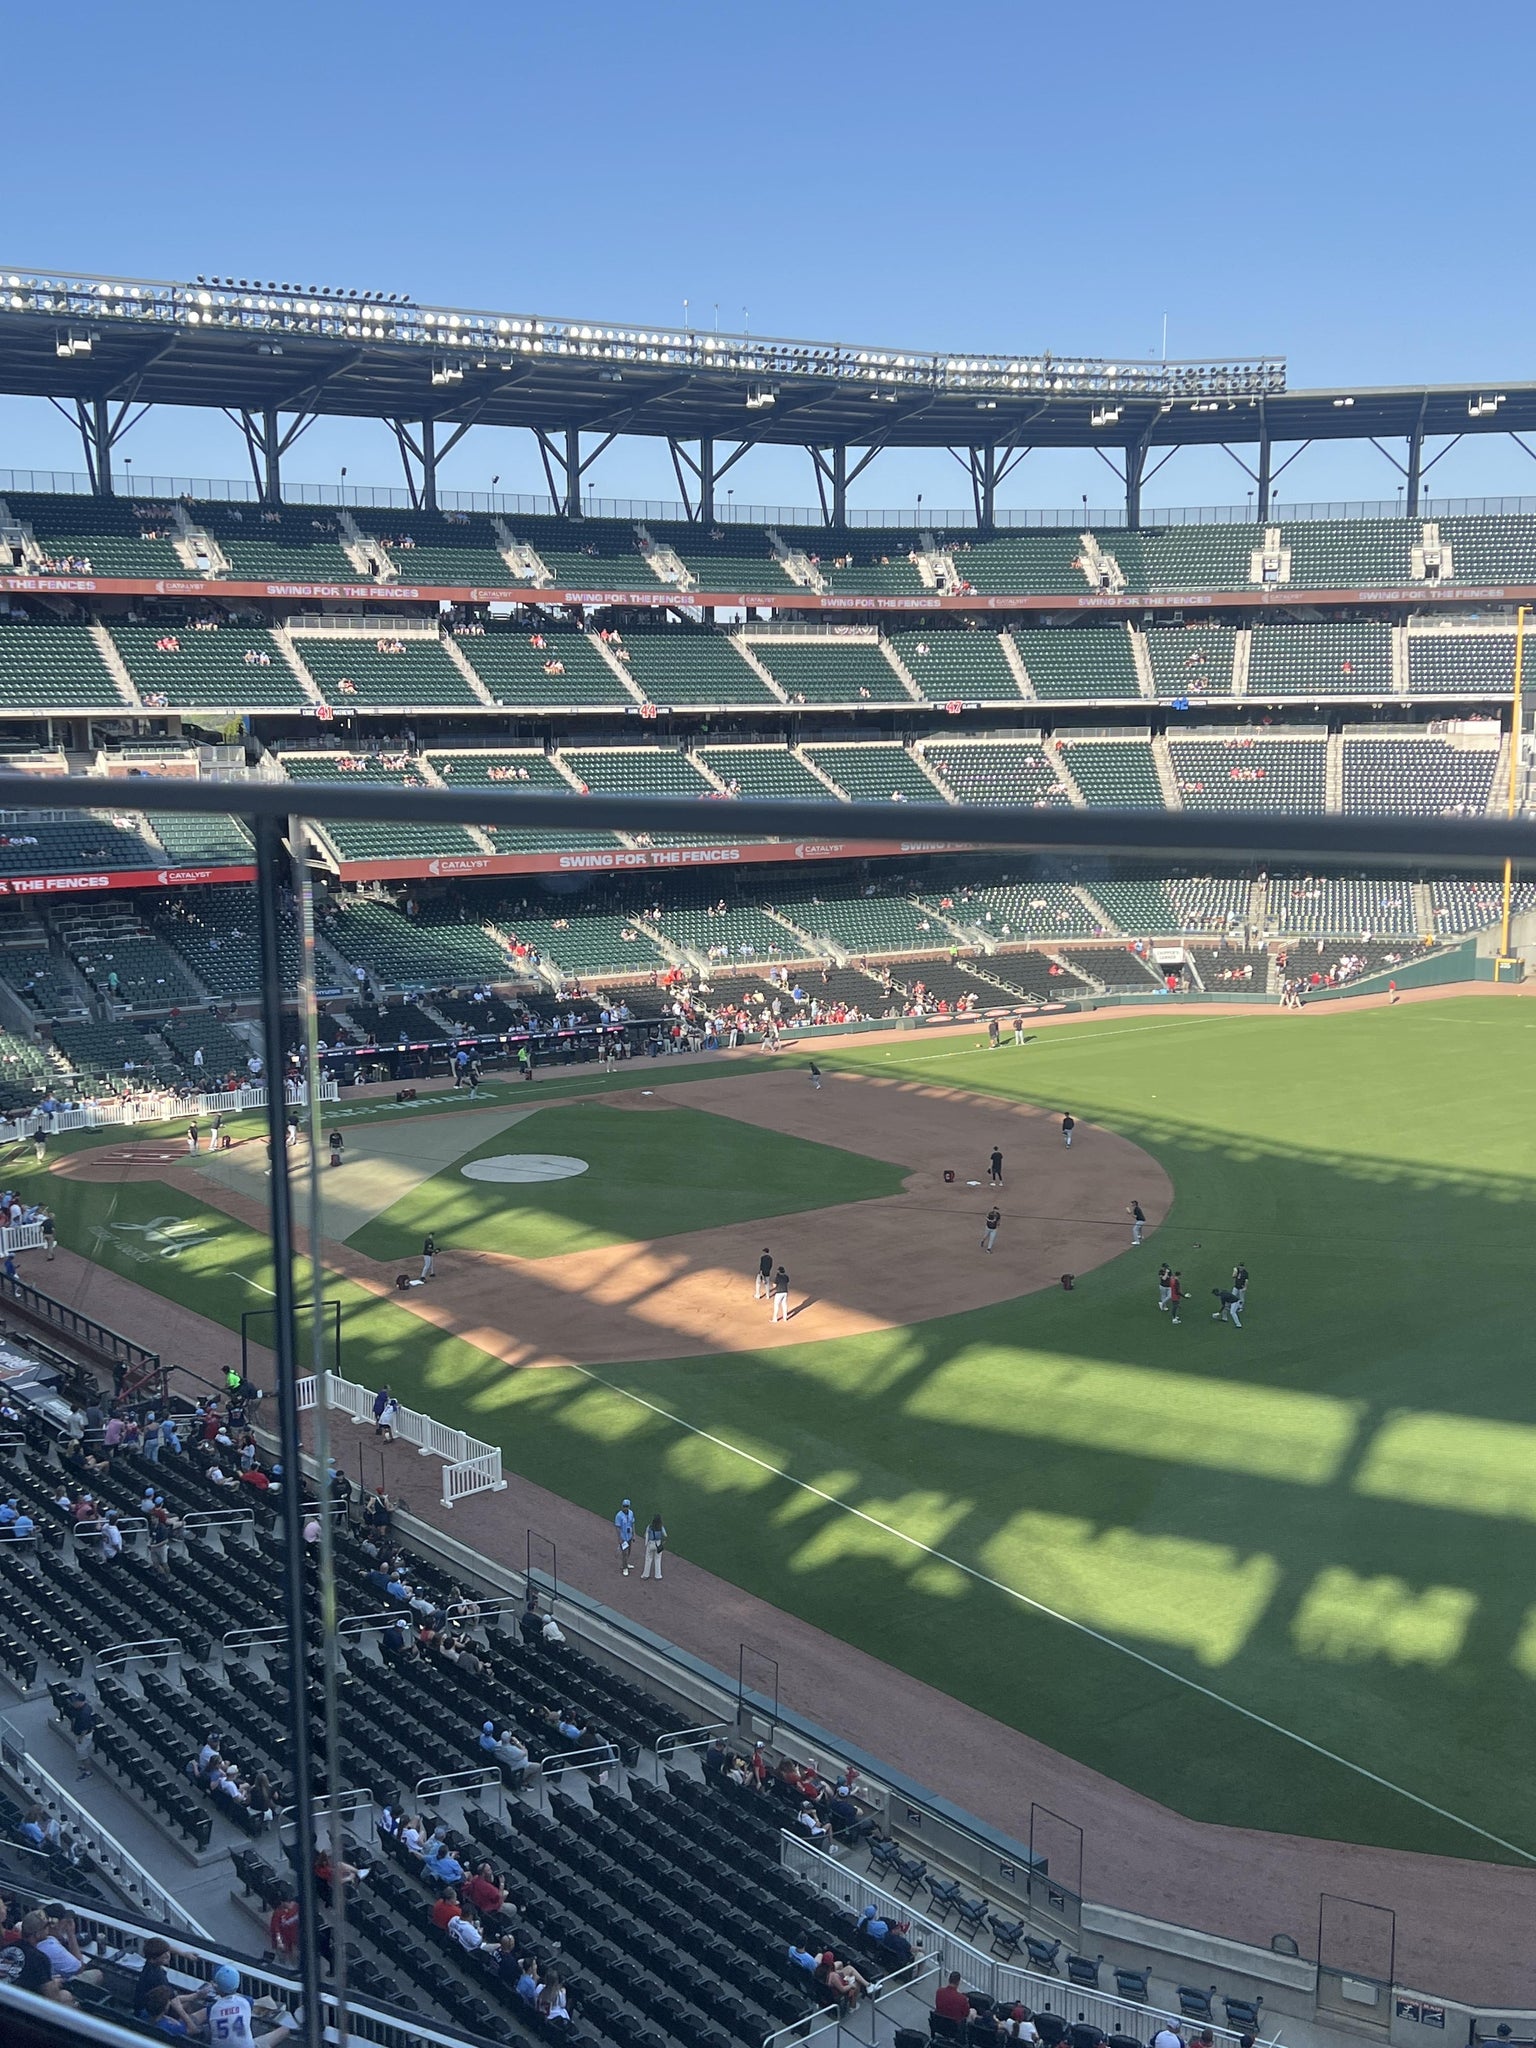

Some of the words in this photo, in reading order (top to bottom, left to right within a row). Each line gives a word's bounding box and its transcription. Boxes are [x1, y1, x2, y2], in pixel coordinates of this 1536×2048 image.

[7, 580, 36, 589] THE
[38, 580, 96, 590] FENCES
[267, 586, 311, 595] SWING
[313, 586, 340, 596] FOR
[343, 587, 368, 596] THE
[370, 587, 419, 597] FENCES
[1359, 591, 1399, 600] SWING
[1401, 590, 1425, 599] FOR
[1430, 590, 1453, 598] THE
[1454, 589, 1504, 598] FENCES
[565, 593, 602, 602] SWING
[604, 594, 627, 602] FOR
[630, 594, 652, 603] THE
[652, 595, 695, 604] FENCES
[821, 599, 854, 607] SWING
[855, 599, 876, 607] FOR
[878, 599, 896, 607] THE
[897, 599, 941, 607] FENCES
[1078, 598, 1115, 606] SWING
[1117, 597, 1139, 605] FOR
[1142, 597, 1164, 605] THE
[1166, 596, 1212, 604] FENCES
[946, 700, 962, 713] 47
[1172, 698, 1188, 710] 42
[315, 705, 334, 720] 41
[640, 704, 657, 718] 44
[805, 845, 843, 853] CATALYST
[442, 859, 490, 869] CATALYST
[560, 855, 613, 867] SWING
[615, 854, 646, 865] FOR
[651, 852, 680, 863] THE
[682, 850, 740, 862] FENCES
[169, 871, 212, 879] CATALYST
[12, 880, 44, 891] THE
[46, 876, 109, 889] FENCES
[217, 2015, 245, 2039] 54
